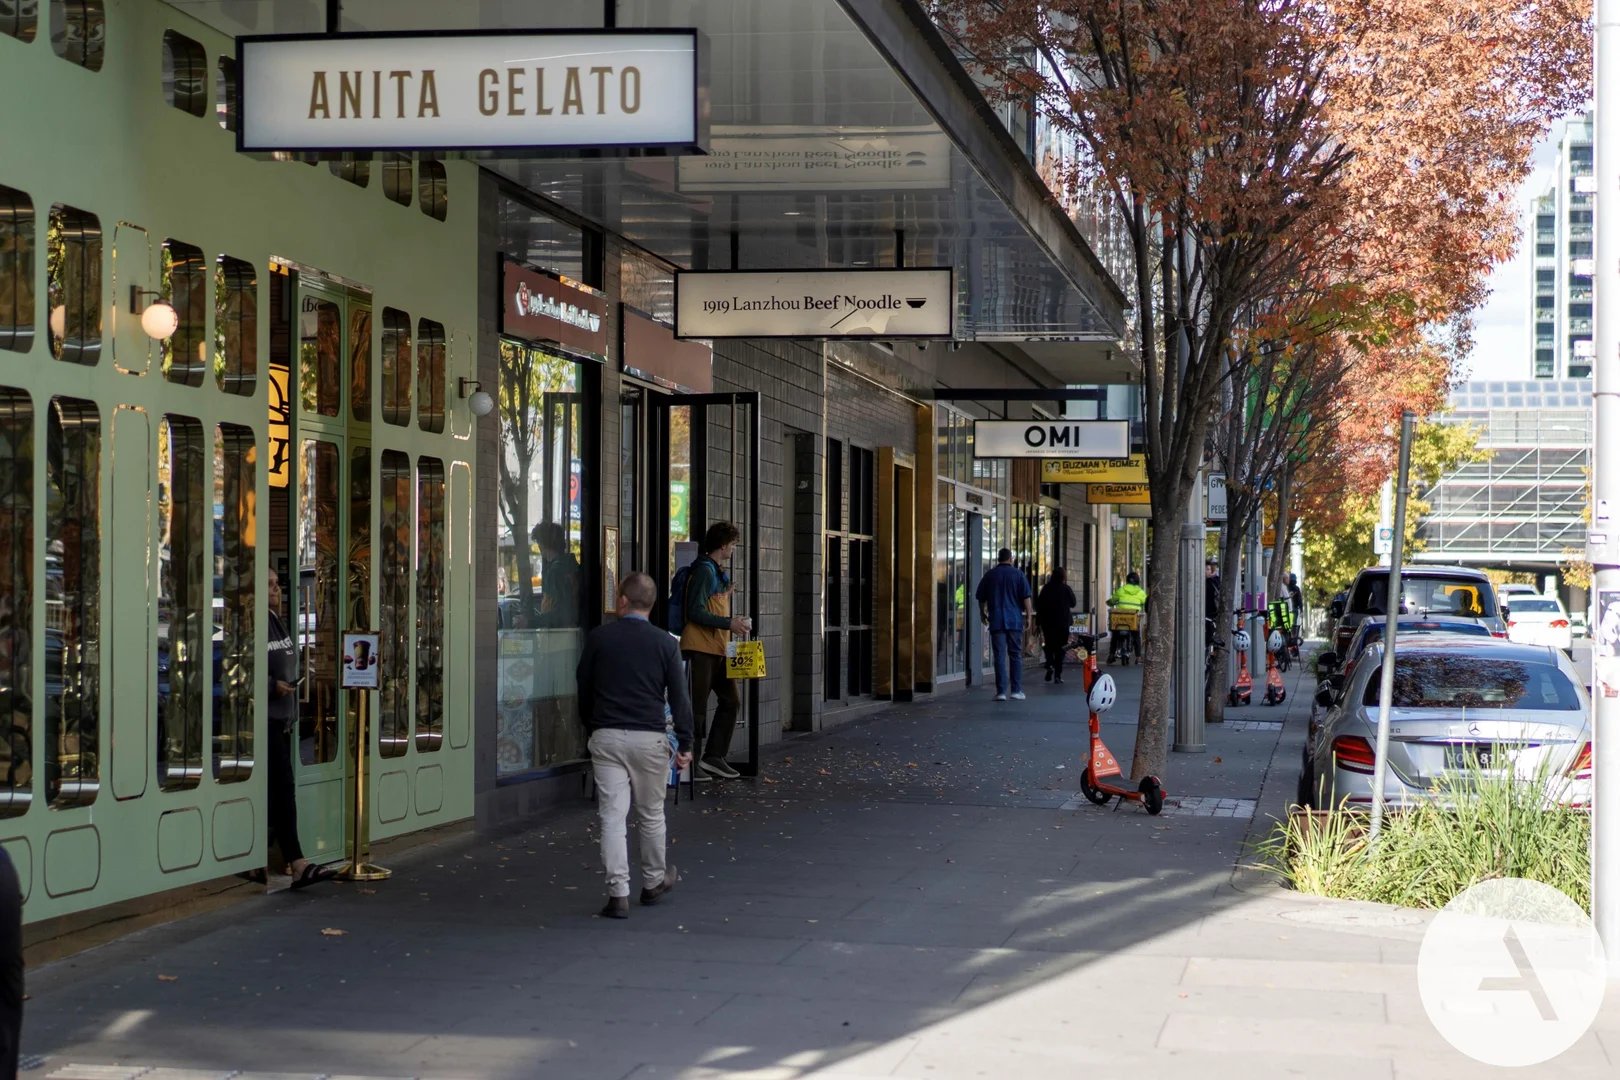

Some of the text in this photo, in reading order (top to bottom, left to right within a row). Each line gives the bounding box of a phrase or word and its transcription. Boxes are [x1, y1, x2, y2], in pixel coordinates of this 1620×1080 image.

[307, 66, 641, 119] ANITA GELATO
[703, 294, 902, 314] 1919 Lanzhou Beef Noodle
[1024, 425, 1080, 447] OMI
[1063, 461, 1100, 469] GUZMAN
[1109, 460, 1140, 468] GOMEZ
